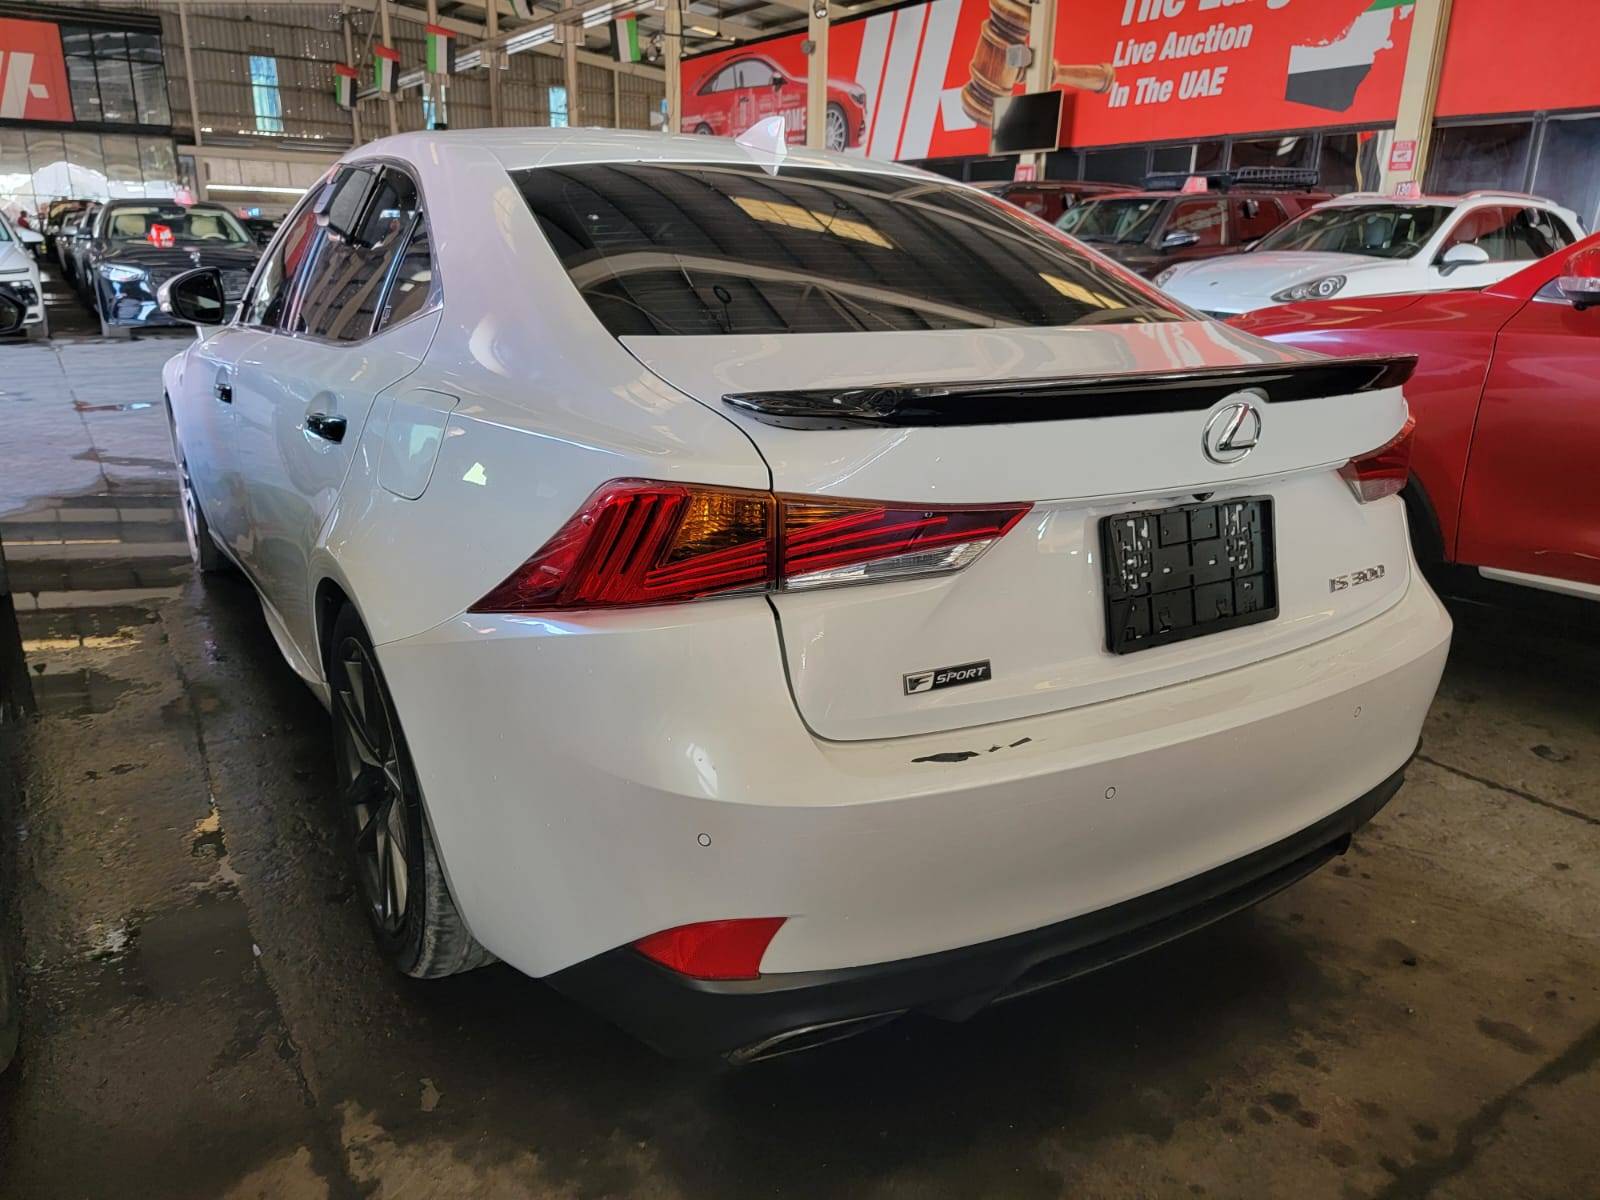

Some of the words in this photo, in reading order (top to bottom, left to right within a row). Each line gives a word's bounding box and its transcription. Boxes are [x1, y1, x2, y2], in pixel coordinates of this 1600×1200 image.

[1112, 39, 1157, 68] Live
[1159, 22, 1253, 61] Auction
[1108, 82, 1130, 108] In
[1134, 76, 1173, 105] The
[1178, 66, 1228, 100] UAE
[1329, 575, 1349, 593] IS
[1351, 564, 1385, 587] 300
[936, 666, 986, 684] SPORT
